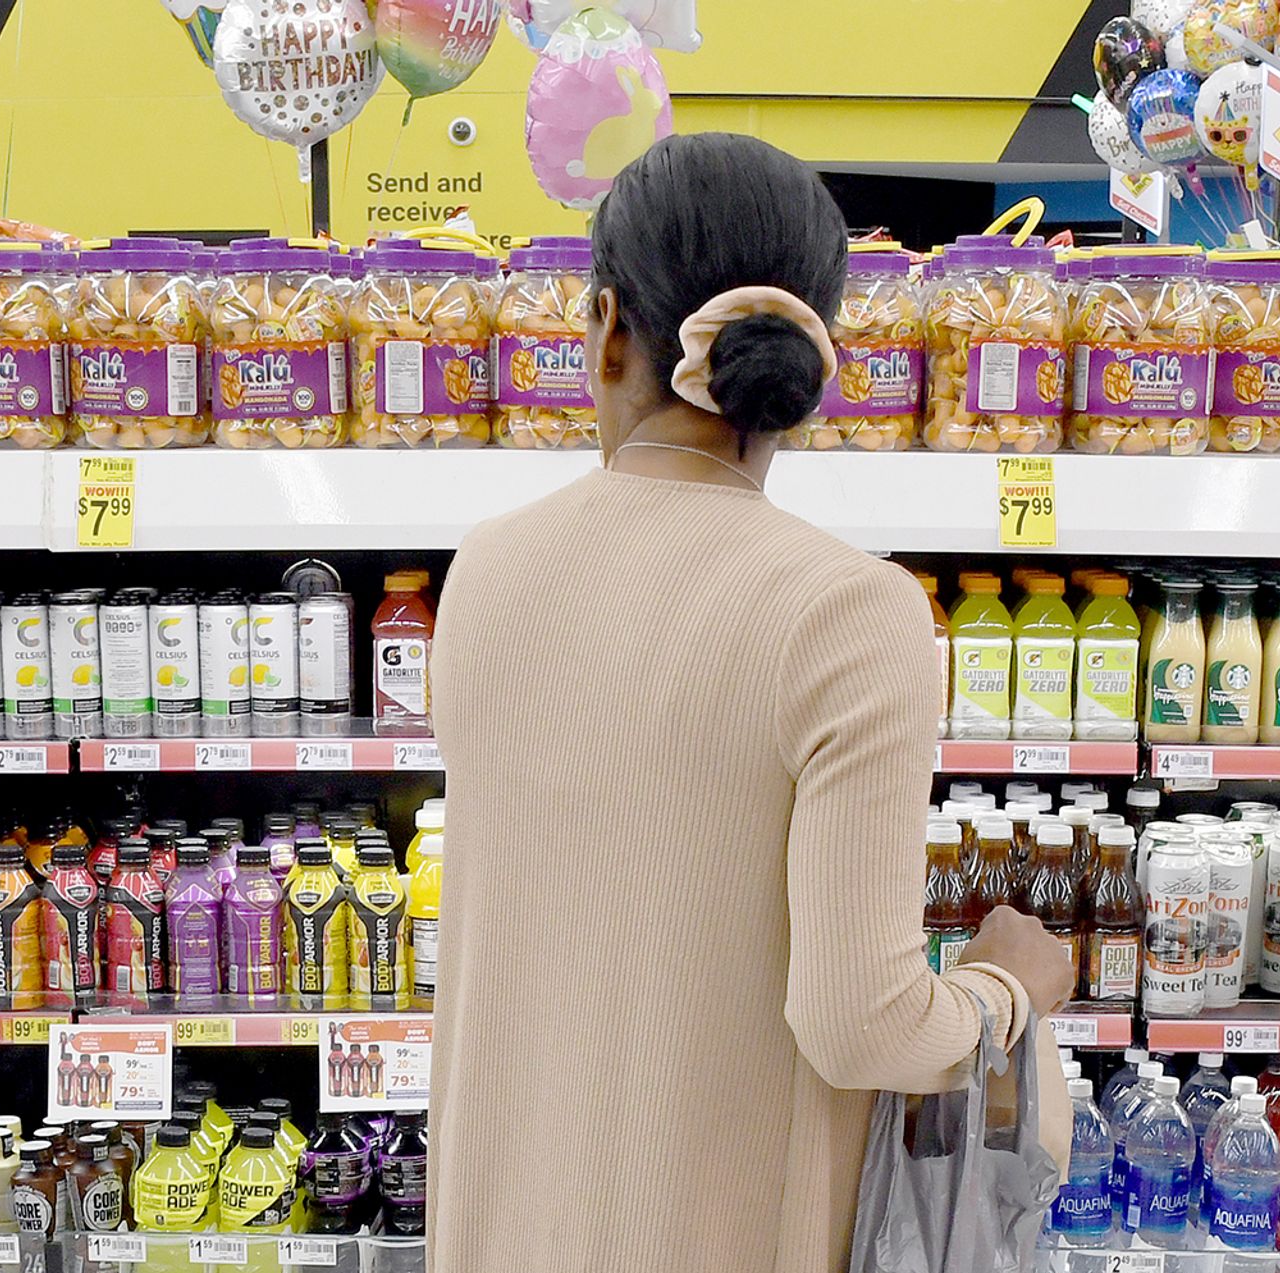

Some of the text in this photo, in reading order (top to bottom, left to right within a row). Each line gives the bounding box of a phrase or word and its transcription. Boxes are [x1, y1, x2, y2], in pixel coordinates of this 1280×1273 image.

[261, 18, 349, 56] HAPPY
[237, 51, 373, 92] BIRTHDAY!
[367, 173, 482, 193] Send and
[84, 485, 129, 497] WOW!!!
[1004, 486, 1050, 497] WOW!!!
[969, 681, 1004, 692] ZERO
[1030, 681, 1066, 692] ZERO
[1093, 681, 1129, 693] ZERO
[259, 915, 271, 990] BODYARMOR
[303, 917, 315, 991] BODYARMOR
[376, 917, 389, 993] BODYARMOR
[1105, 946, 1135, 962] GOLD
[1104, 961, 1135, 976] PEAK
[93, 1190, 120, 1208] CORE
[93, 1208, 121, 1222] POWER
[1214, 1208, 1272, 1231] AQUAFINA
